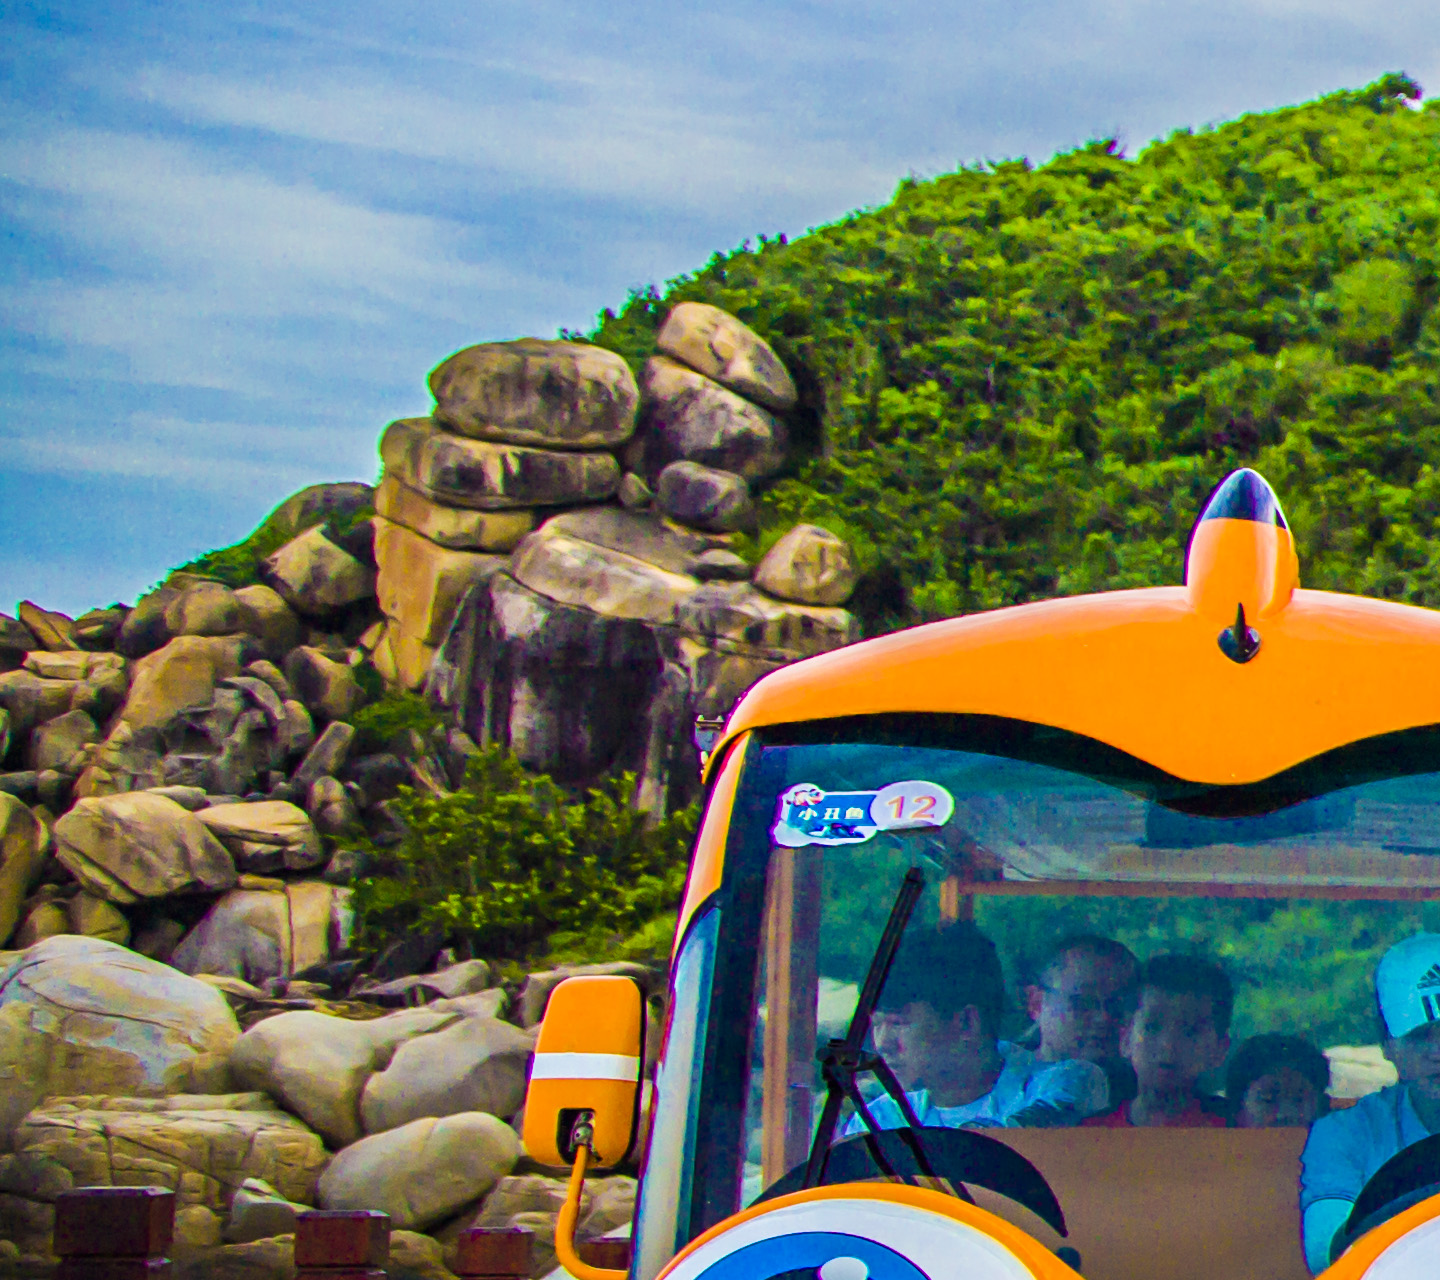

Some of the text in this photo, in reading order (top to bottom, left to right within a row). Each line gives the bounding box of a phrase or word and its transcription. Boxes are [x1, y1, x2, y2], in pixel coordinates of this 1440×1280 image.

[798, 807, 864, 821] 小丑鱼
[887, 795, 937, 819] 12
